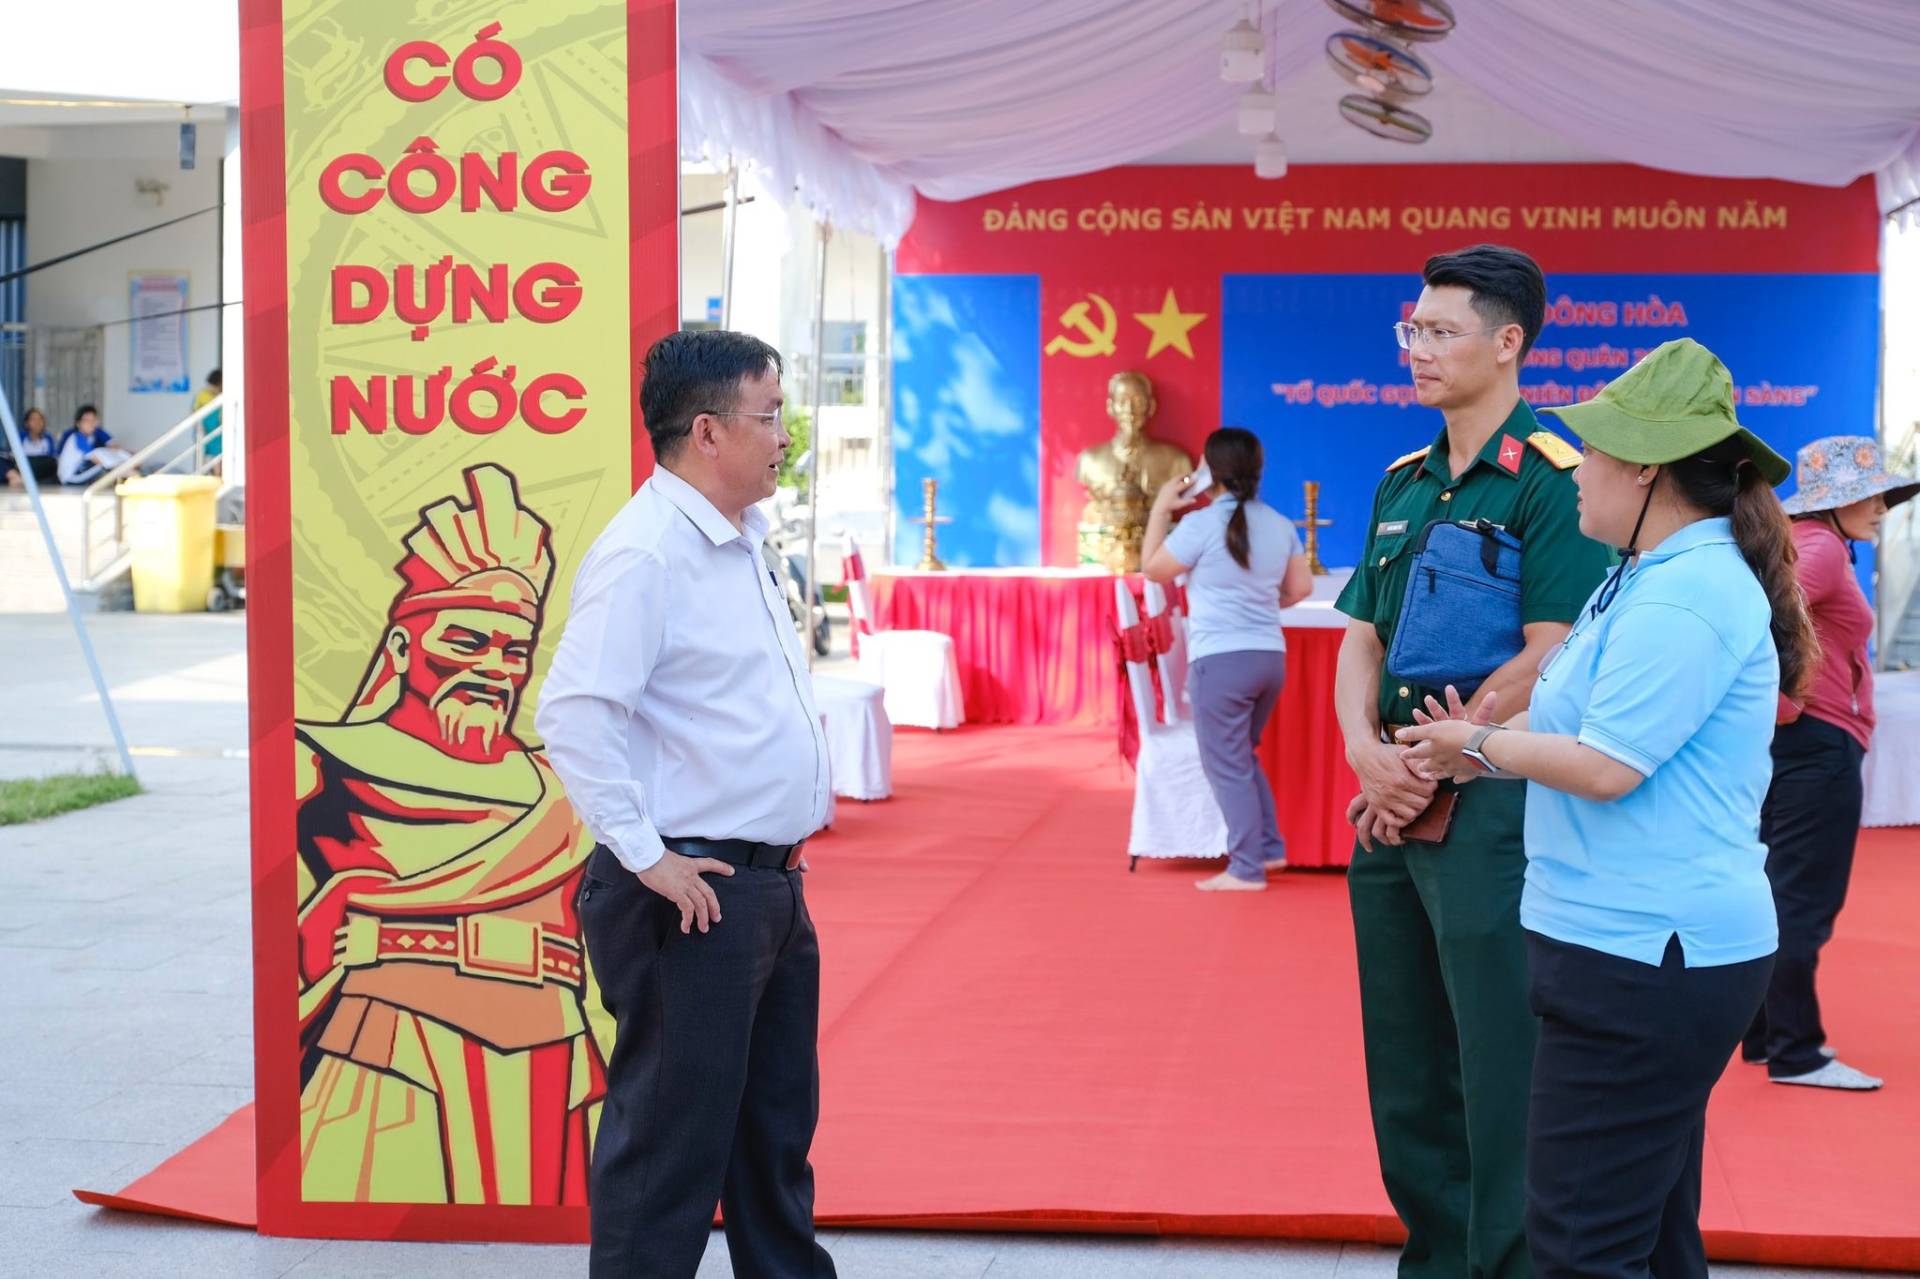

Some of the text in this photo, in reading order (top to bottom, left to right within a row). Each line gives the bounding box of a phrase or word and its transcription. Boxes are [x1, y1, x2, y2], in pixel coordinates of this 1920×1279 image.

[384, 21, 523, 103] CÓ
[318, 136, 592, 215] CÔNG
[982, 200, 1788, 236] ĐẢNG CỘNG SẢN VIỆT NAM QUANG VINH MUÔN NĂM
[331, 255, 583, 341] DỰNG
[1622, 294, 1688, 326] HÒA
[330, 355, 588, 436] NƯỚC
[1566, 343, 1628, 372] QUÂN
